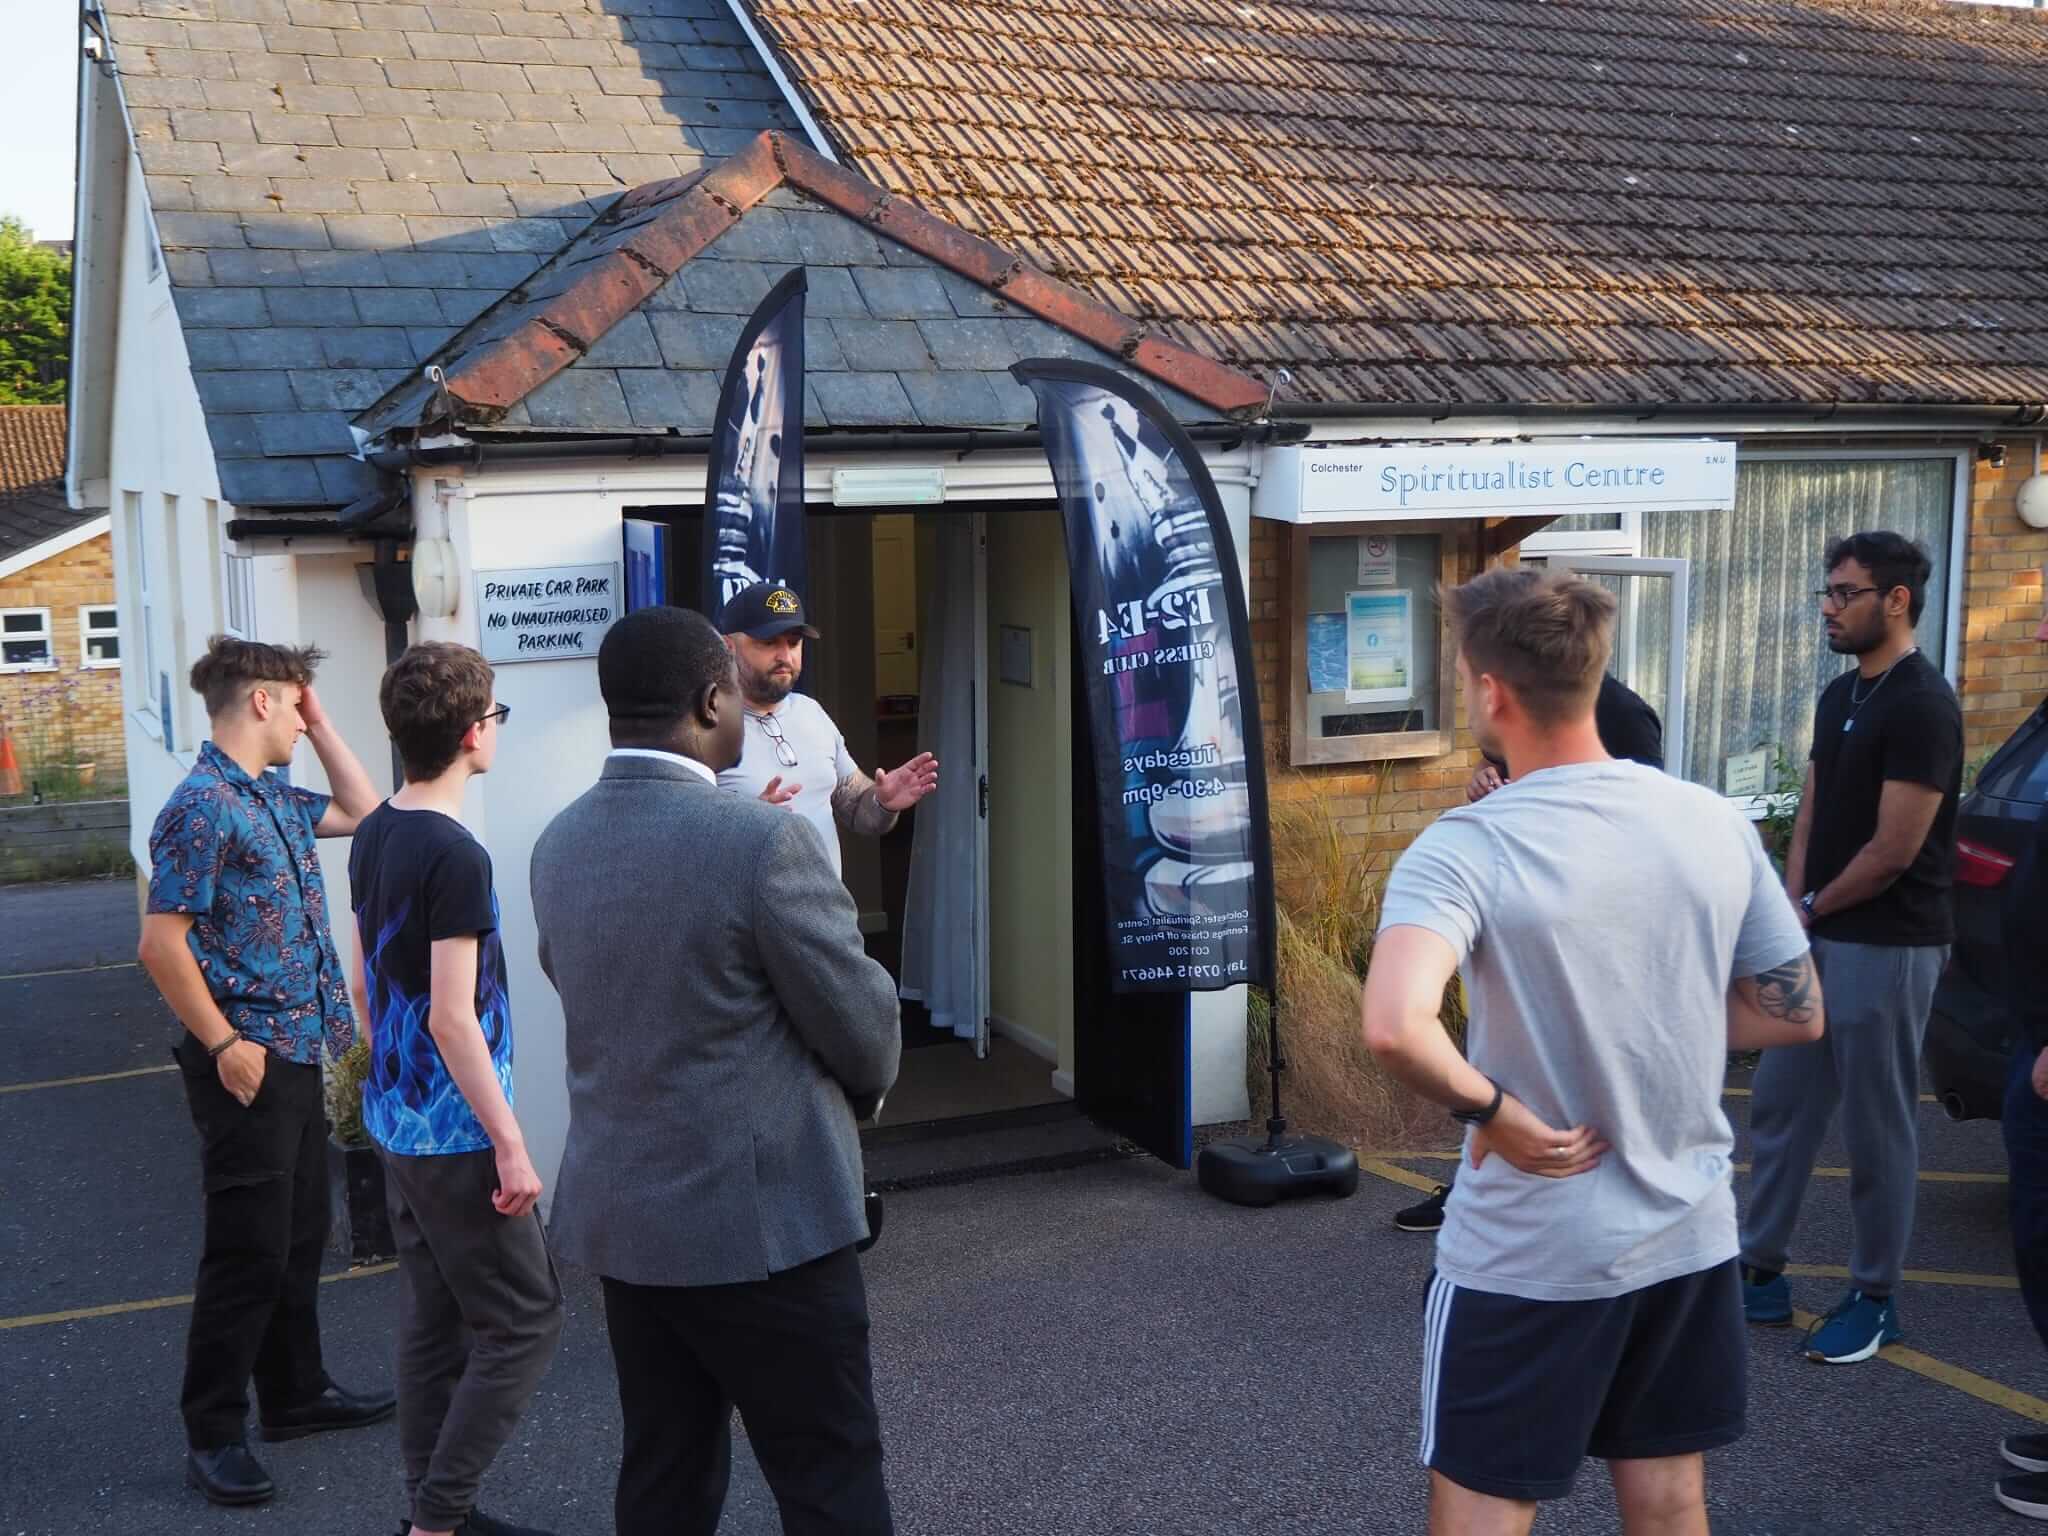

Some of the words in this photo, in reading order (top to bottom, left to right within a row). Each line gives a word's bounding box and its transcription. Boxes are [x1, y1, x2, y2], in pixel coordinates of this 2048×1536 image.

[1310, 462, 1364, 474] Colchester
[1380, 461, 1554, 506] Spiritualist
[1564, 462, 1666, 488] Centre
[485, 582, 542, 599] PRIVATE
[545, 579, 571, 596] CAR
[575, 577, 608, 594] PARK
[487, 612, 506, 628] NO
[511, 607, 609, 626] UNAUTHORISED
[517, 631, 583, 649] PARKING
